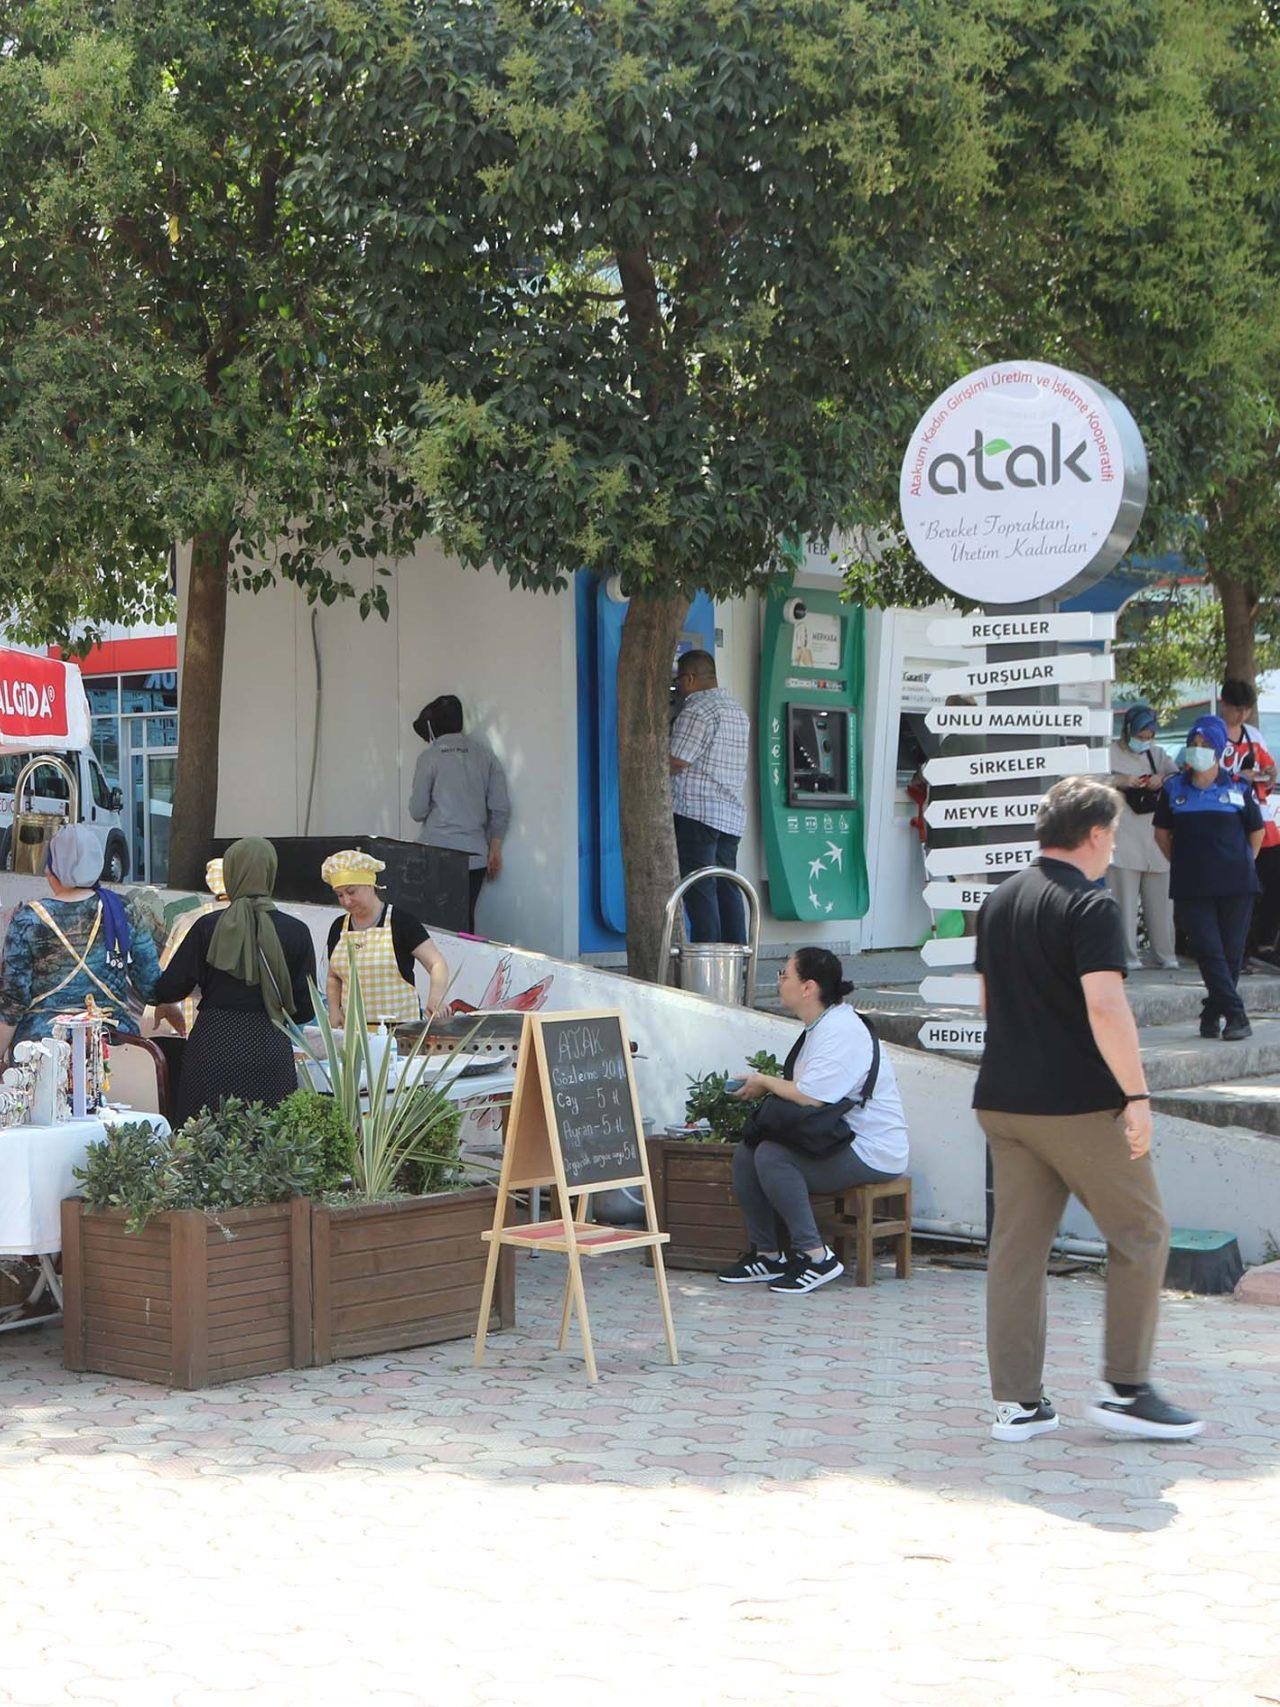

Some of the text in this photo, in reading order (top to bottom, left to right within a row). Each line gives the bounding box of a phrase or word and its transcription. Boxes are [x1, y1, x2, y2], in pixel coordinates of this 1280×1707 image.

[910, 446, 928, 496] Atakum
[991, 371, 1033, 386] Üretim
[1036, 375, 1050, 388] ve
[928, 422, 1092, 496] atak
[972, 621, 1050, 640] REÇELLER
[967, 665, 1054, 686] TURŞULAR
[936, 709, 1083, 727] UNLU MAMÜLLER
[970, 756, 1046, 775] SİRKELER
[944, 803, 1039, 820] MEYVE KUR
[985, 850, 1033, 865] SEPET
[558, 1025, 604, 1062] ATAK
[929, 1028, 987, 1043] HEDİYE
